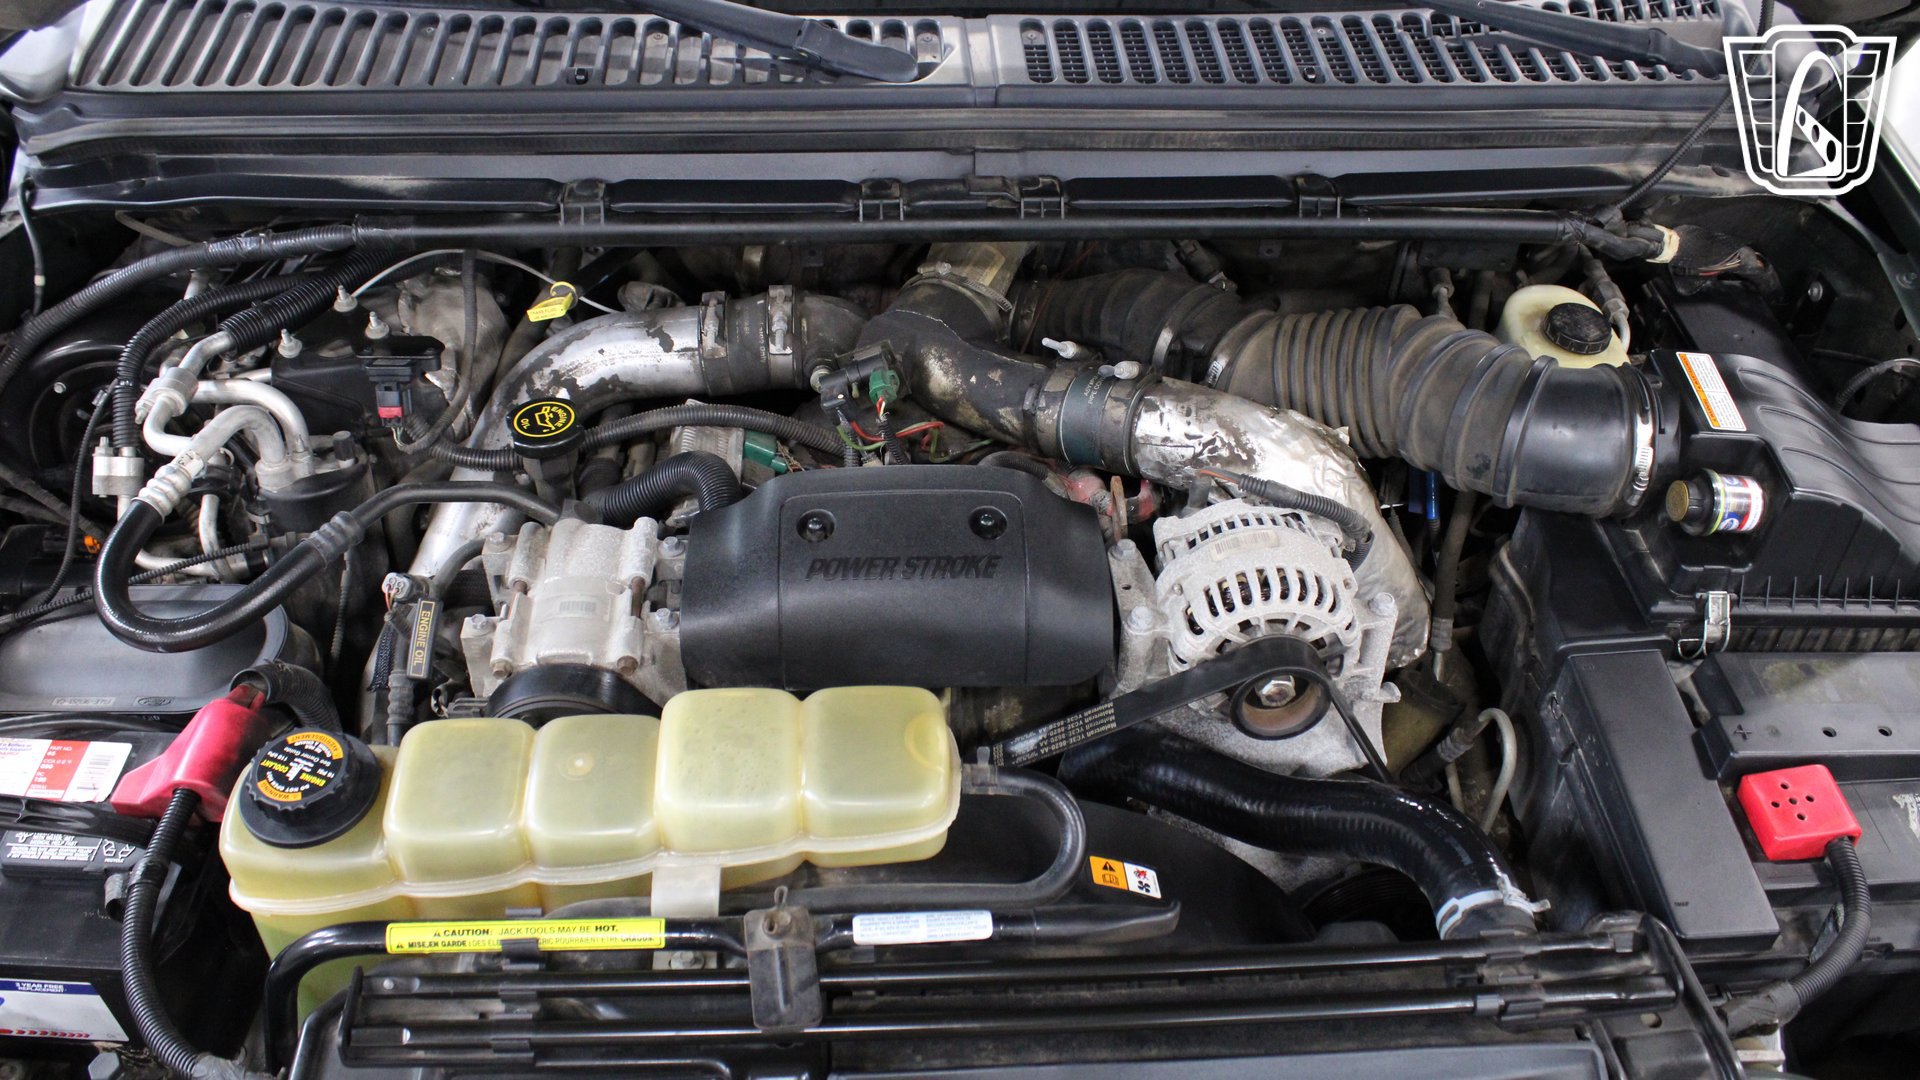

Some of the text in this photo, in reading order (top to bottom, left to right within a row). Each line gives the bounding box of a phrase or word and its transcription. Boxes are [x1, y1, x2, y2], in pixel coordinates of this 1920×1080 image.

[551, 406, 567, 427] ENGINE
[804, 554, 1003, 582] POWER STROKE
[414, 610, 431, 666] ENGINE OIL
[1084, 702, 1113, 716] Motorcraft
[1085, 708, 1114, 722] Motorcraft
[1086, 715, 1115, 729] Motorcraft
[1087, 722, 1116, 737] Motorcraft
[284, 746, 300, 756] Guide
[261, 759, 326, 786] ENGINE COOLANT
[262, 783, 289, 798] WARNING
[444, 929, 493, 937] CAUTION:
